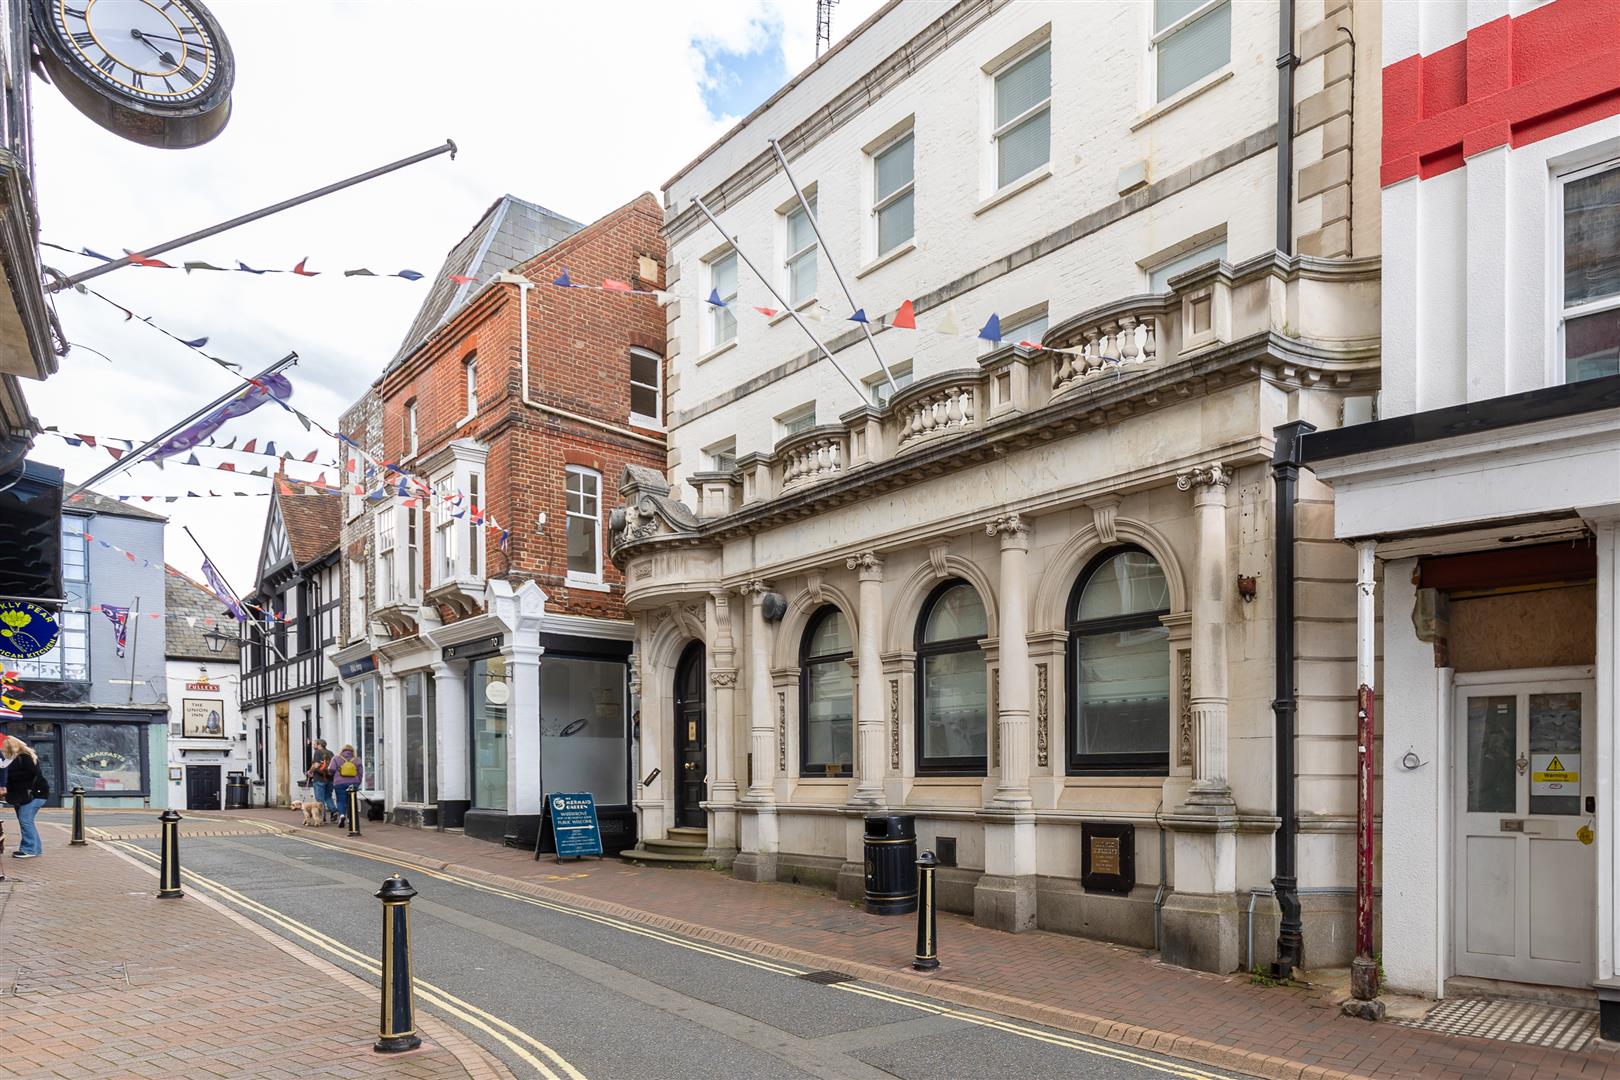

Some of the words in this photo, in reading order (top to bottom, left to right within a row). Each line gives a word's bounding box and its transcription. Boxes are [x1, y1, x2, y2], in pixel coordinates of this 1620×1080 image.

[27, 604, 54, 623] PEAR
[0, 649, 24, 659] ICAN
[26, 638, 56, 658] KITCHEN
[490, 637, 498, 647] 70
